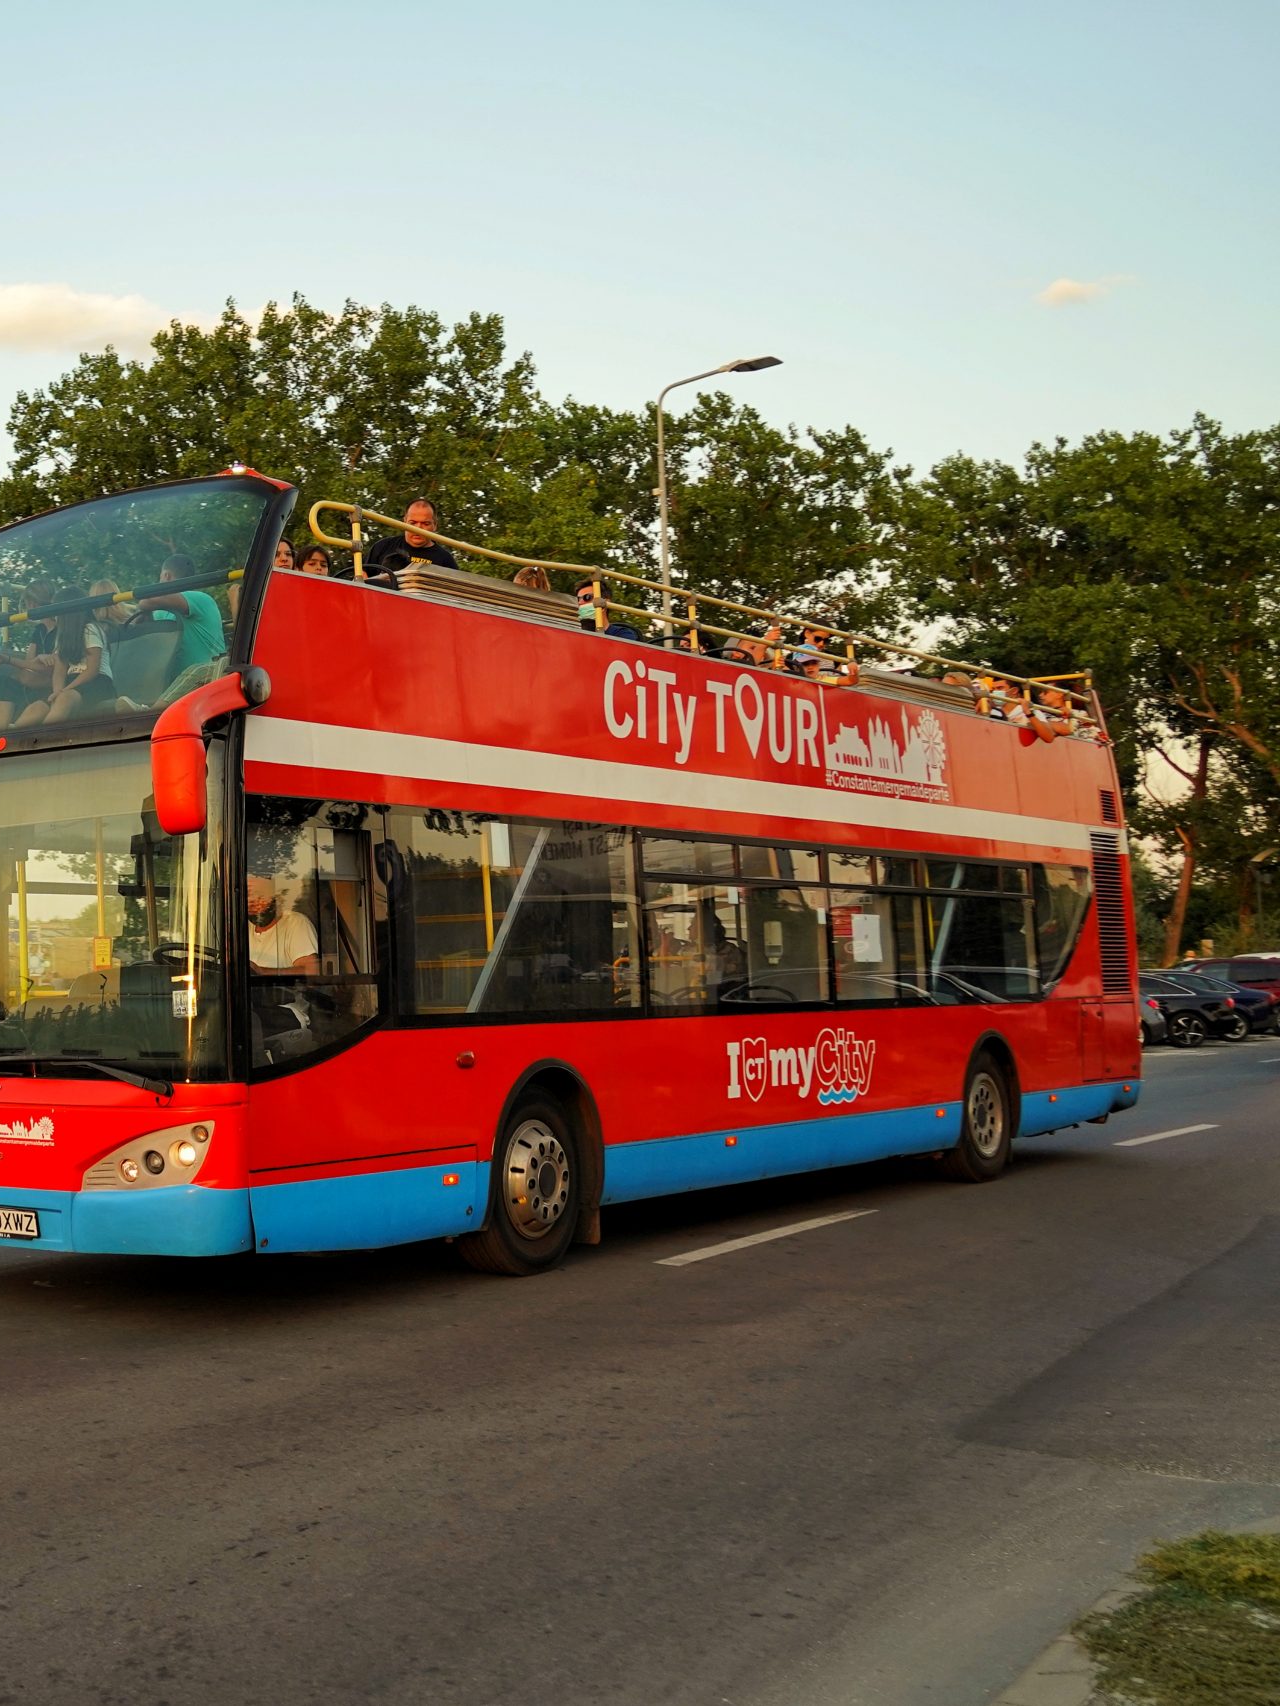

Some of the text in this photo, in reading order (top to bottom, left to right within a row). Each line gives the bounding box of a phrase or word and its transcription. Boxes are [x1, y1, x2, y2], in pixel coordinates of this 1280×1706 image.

[706, 673, 820, 768] TOUR
[726, 1042, 741, 1099] I
[745, 1057, 765, 1081] CT
